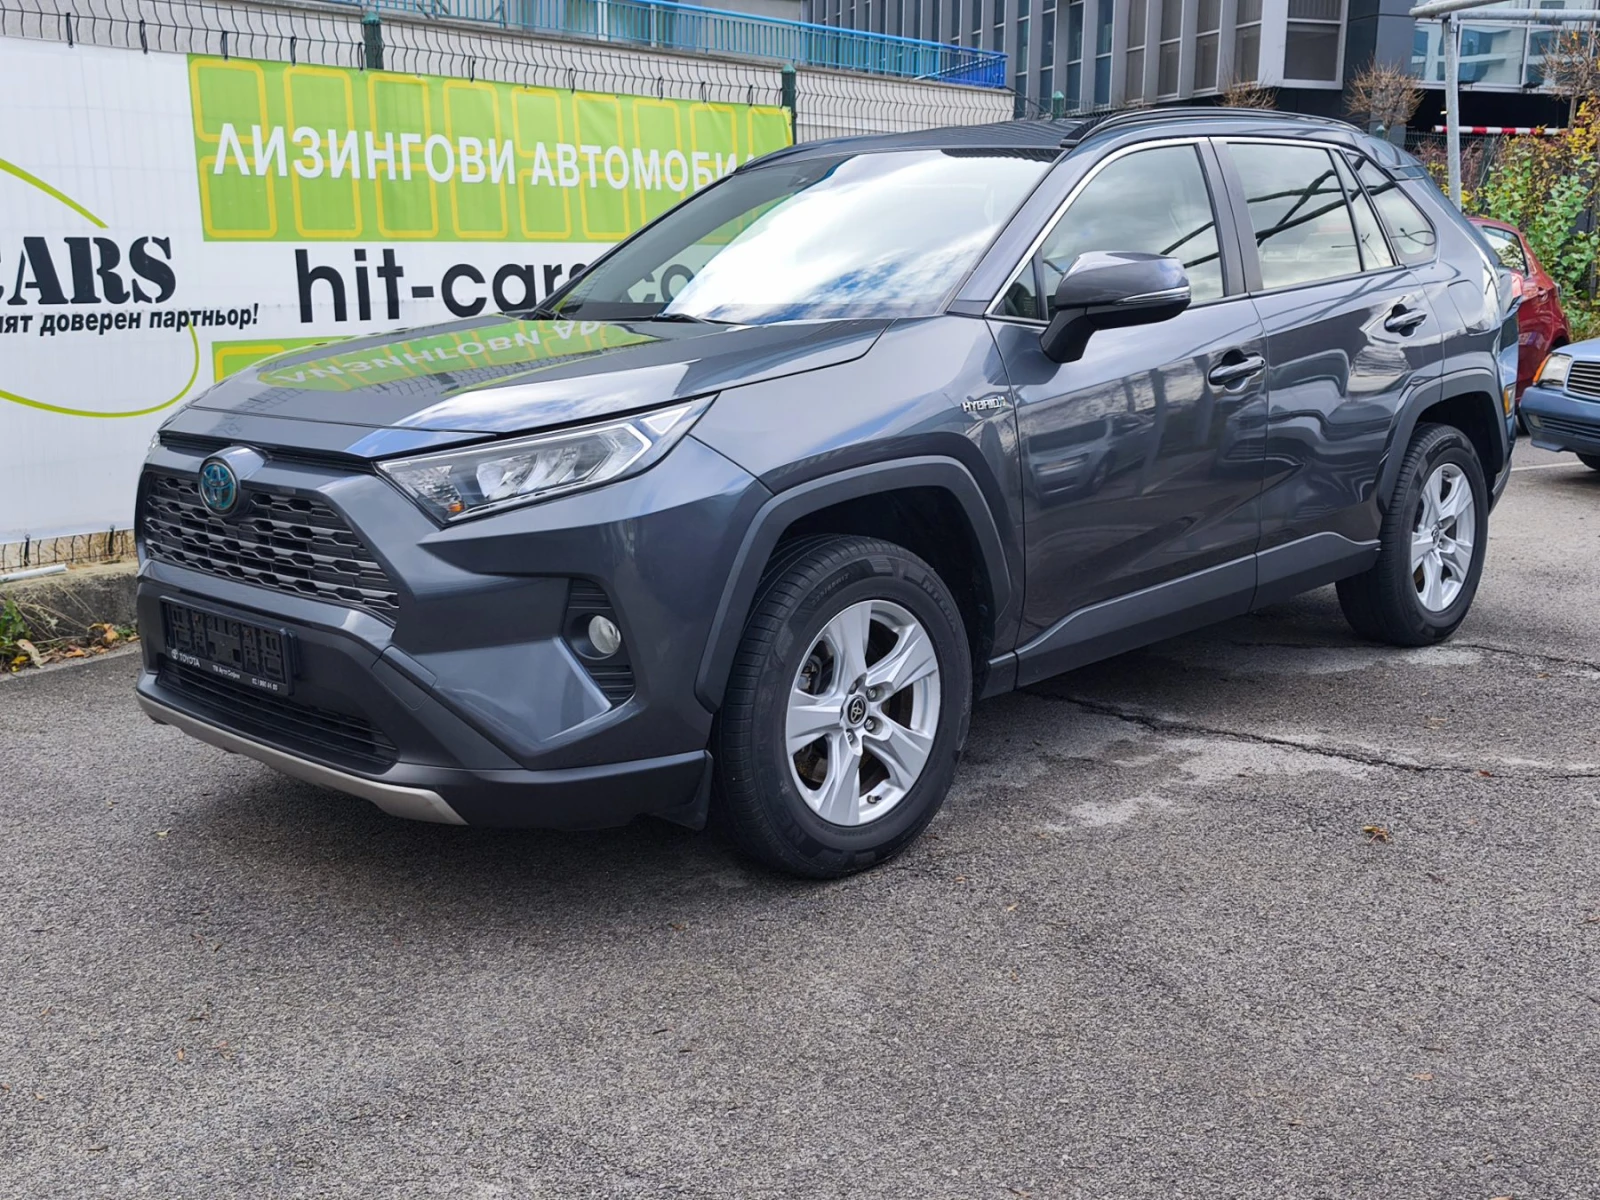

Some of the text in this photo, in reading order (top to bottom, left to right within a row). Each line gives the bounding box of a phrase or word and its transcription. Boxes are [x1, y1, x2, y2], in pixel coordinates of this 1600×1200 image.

[213, 124, 756, 193] ЛИЗИНГОВИ АВТОМОБИ
[0, 236, 177, 306] ARS
[40, 311, 142, 337] доверен
[149, 303, 260, 330] партньор!
[961, 398, 1001, 413] HYBRID
[180, 653, 200, 668] TOYOTA
